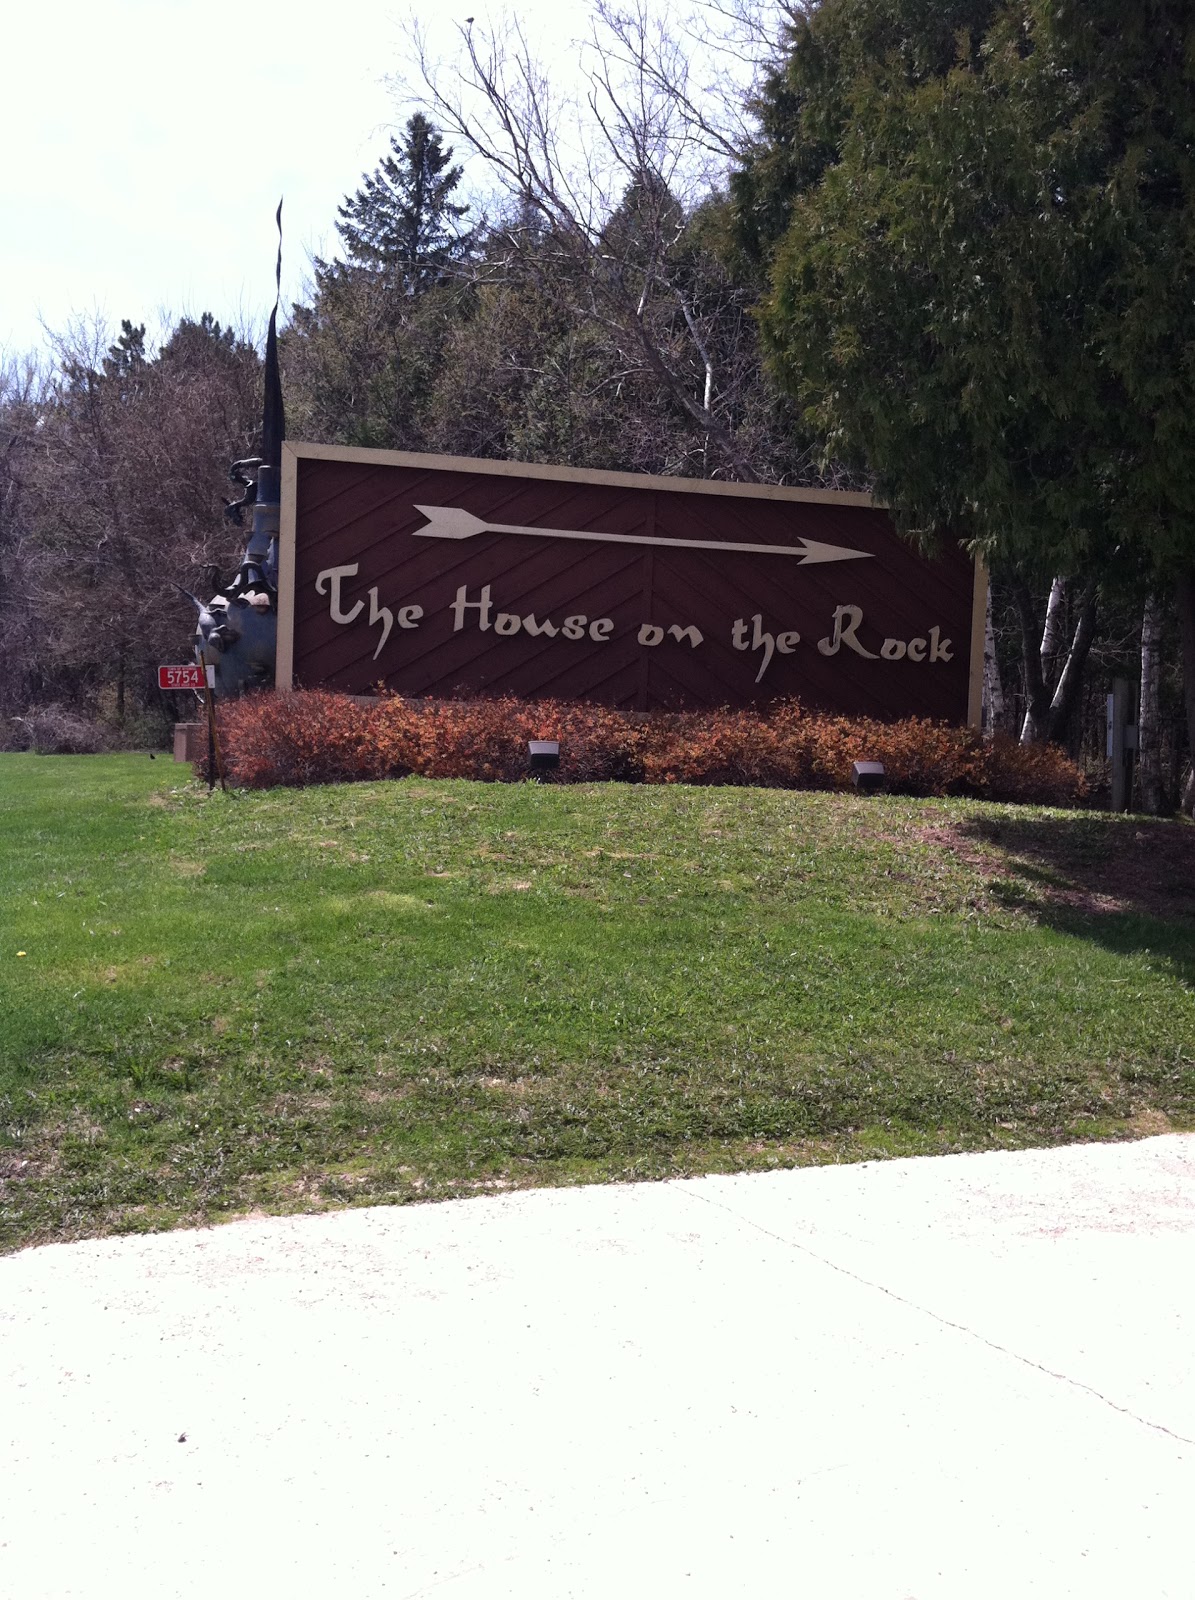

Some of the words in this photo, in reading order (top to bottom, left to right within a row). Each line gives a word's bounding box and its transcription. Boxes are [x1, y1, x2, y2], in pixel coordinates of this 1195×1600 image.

[315, 562, 423, 660] The
[449, 584, 614, 641] House
[637, 623, 704, 648] on
[731, 613, 800, 683] the
[817, 604, 954, 662] Rock
[167, 670, 199, 684] 5754
